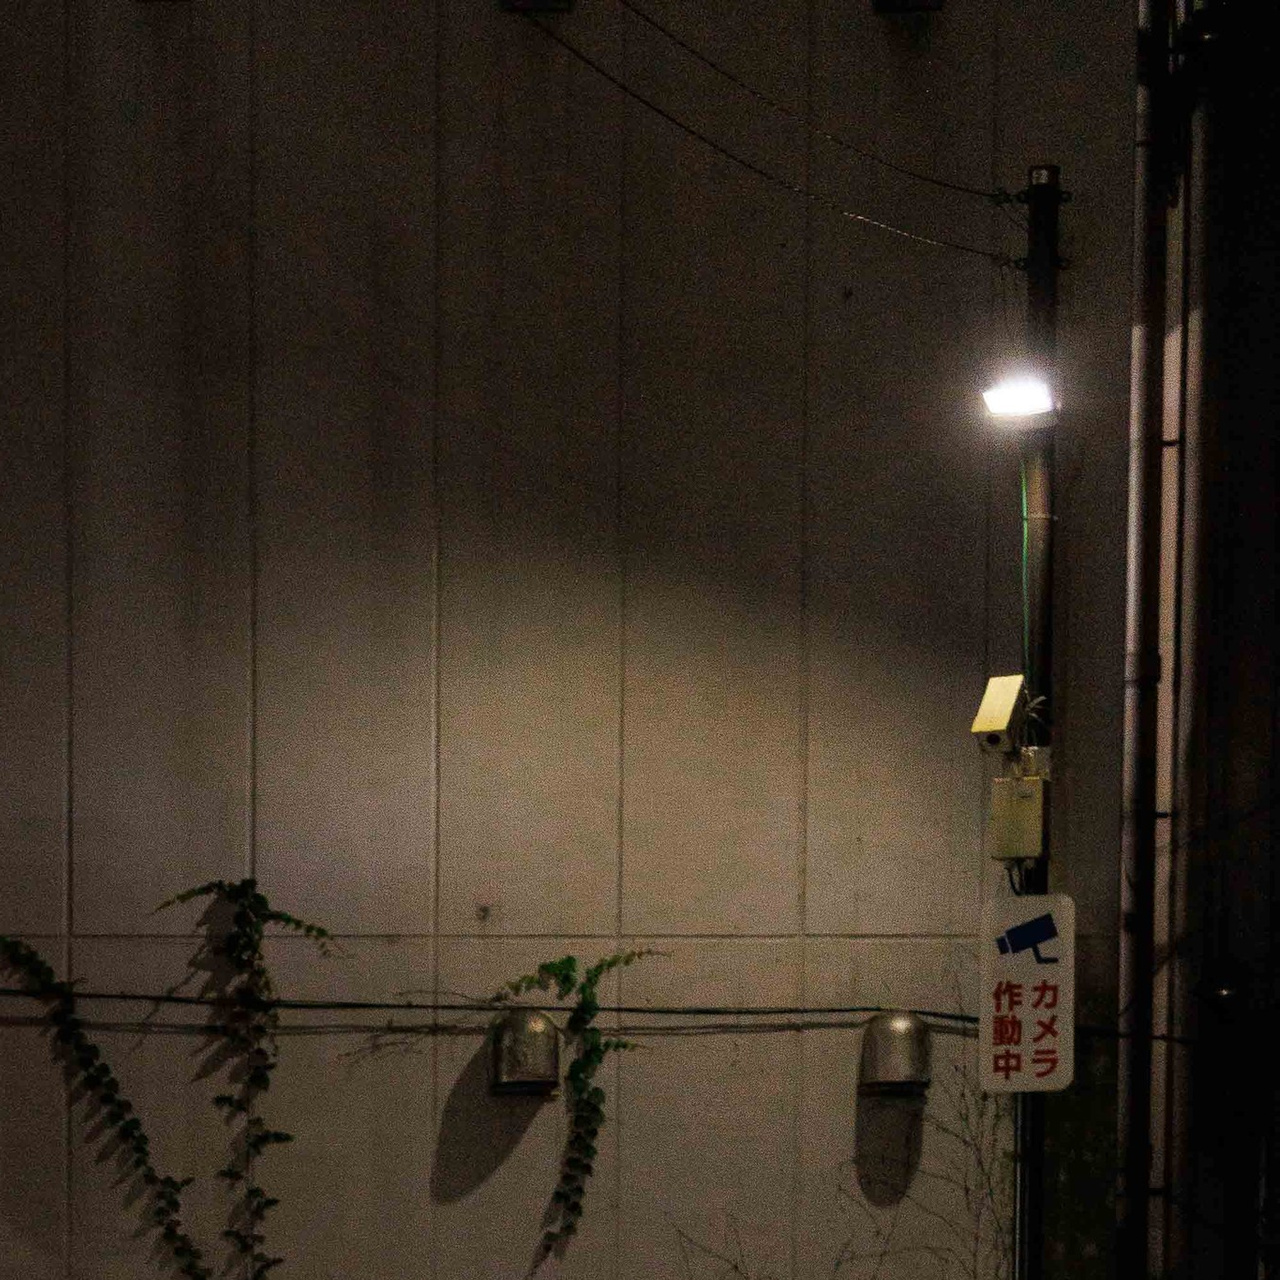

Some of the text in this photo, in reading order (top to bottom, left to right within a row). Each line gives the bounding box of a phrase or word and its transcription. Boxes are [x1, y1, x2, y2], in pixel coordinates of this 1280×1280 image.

[992, 980, 1023, 1080] 作動中
[1031, 978, 1060, 1079] カメラ
